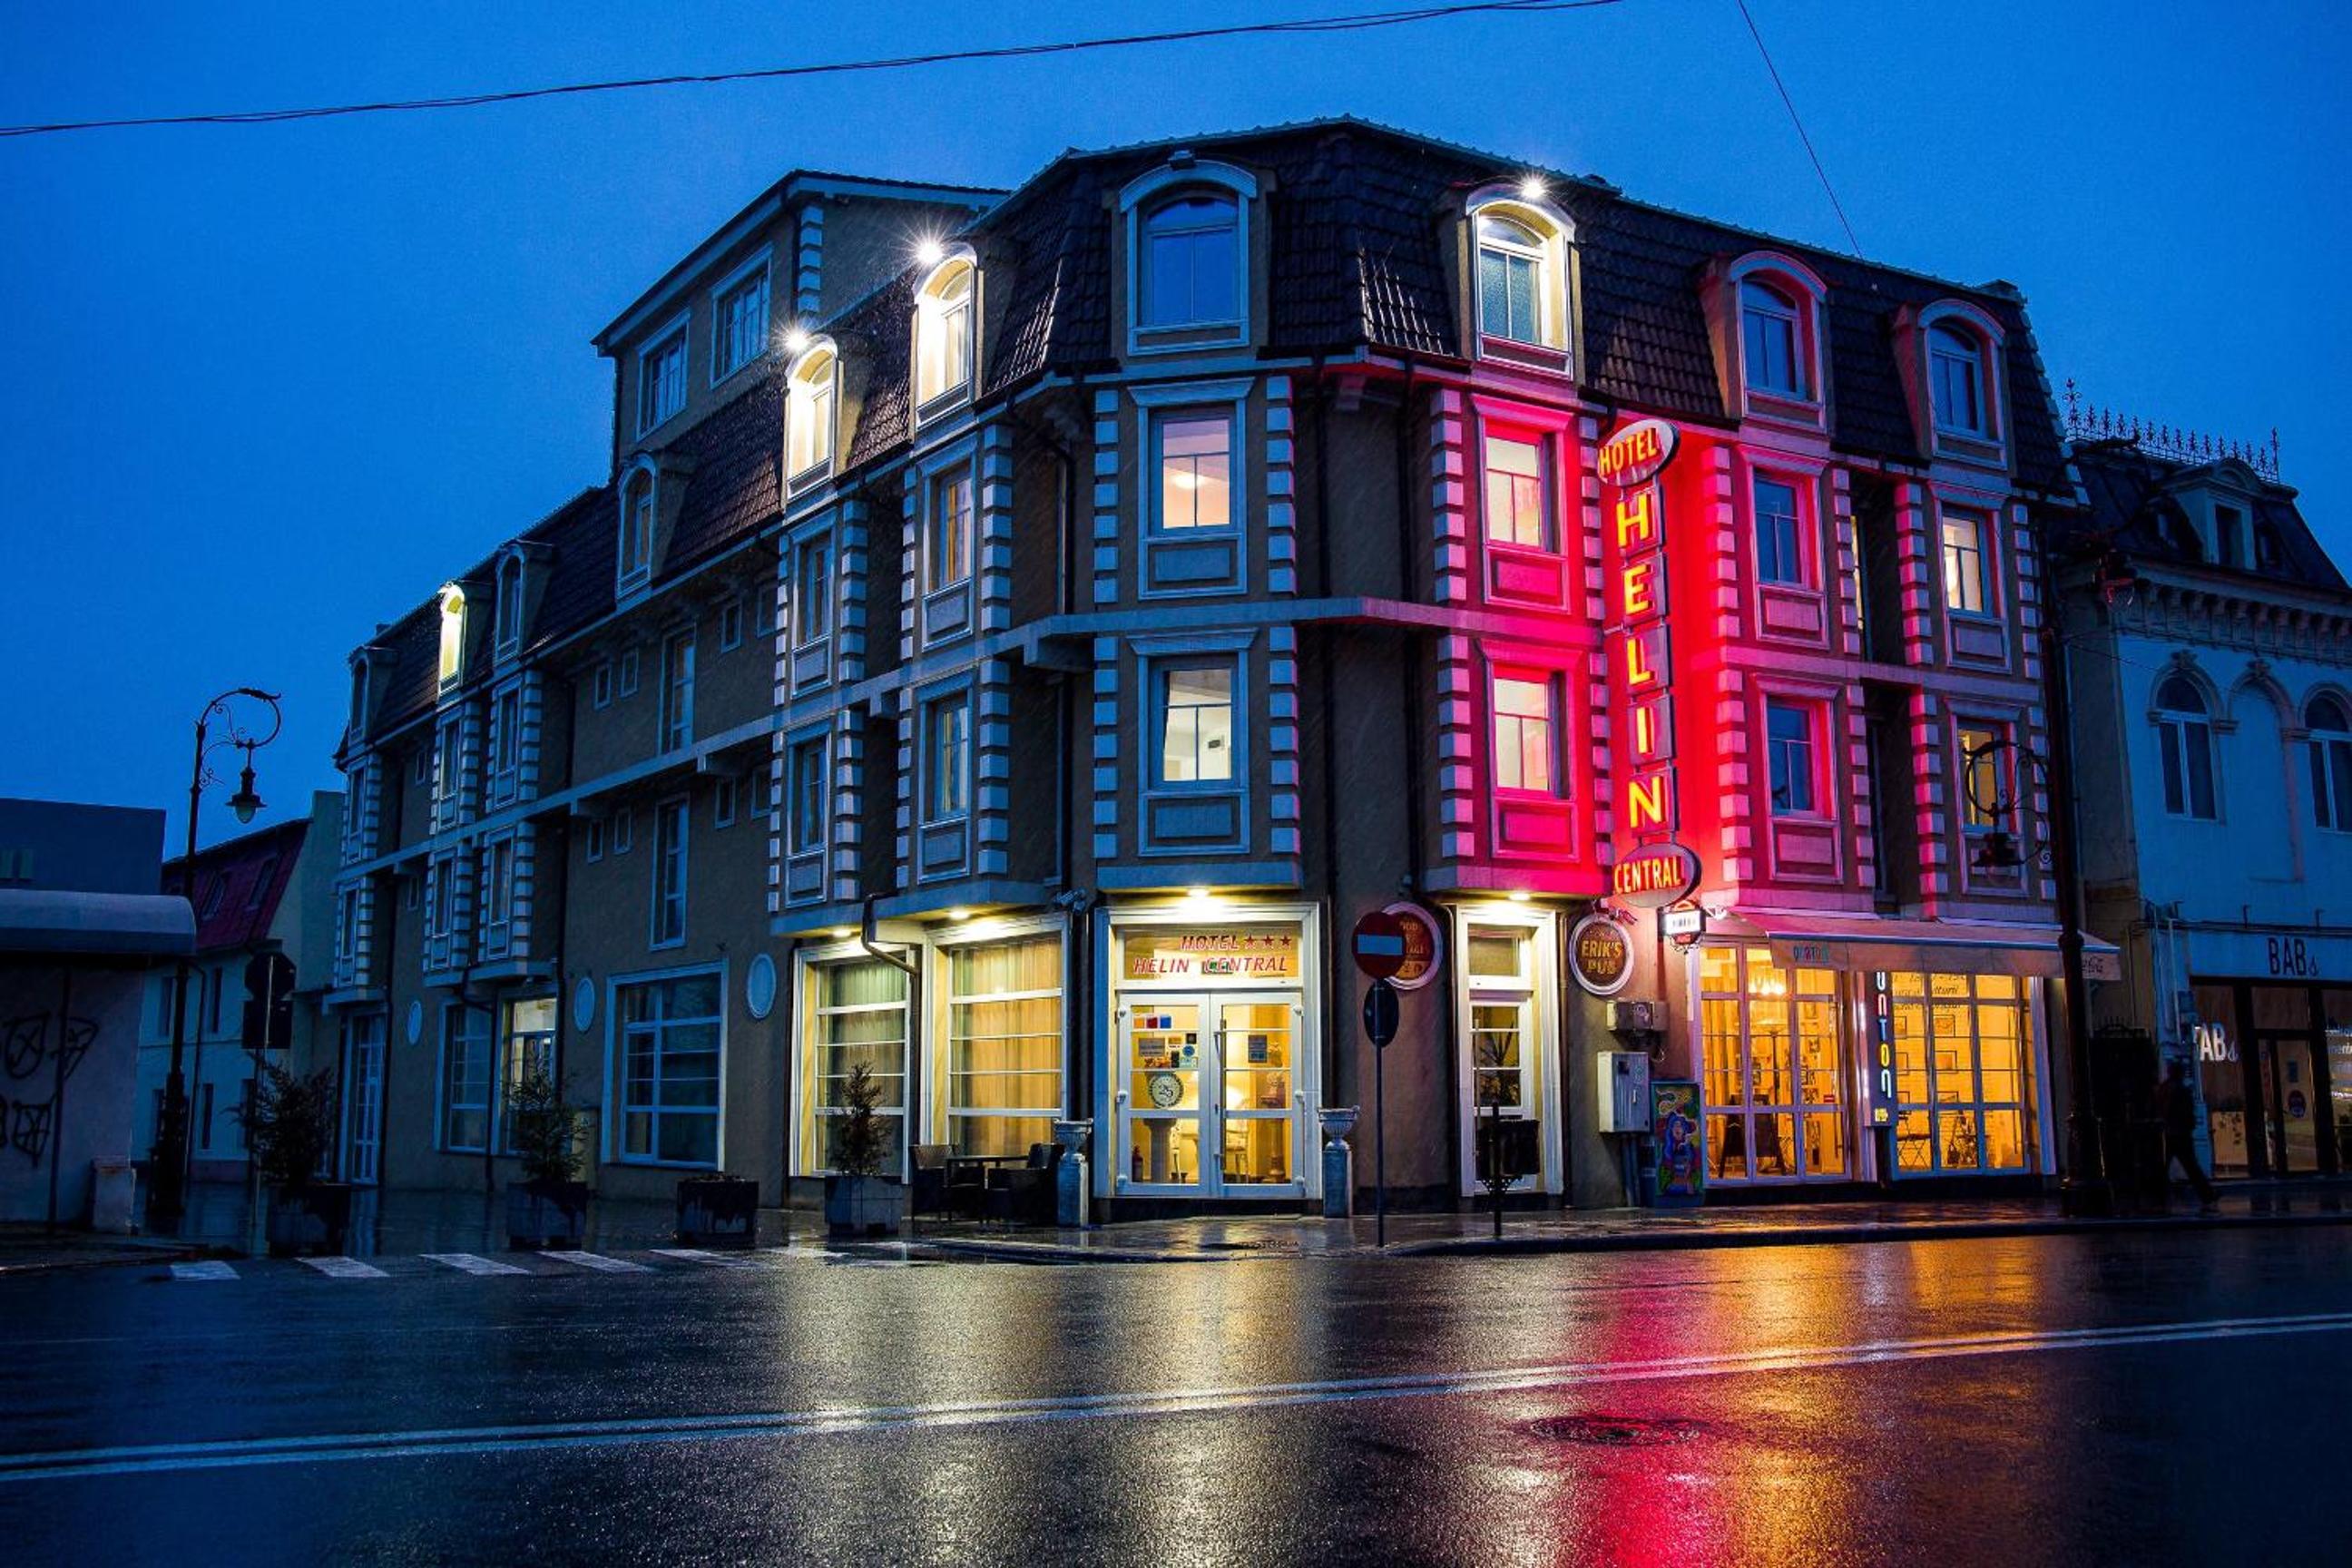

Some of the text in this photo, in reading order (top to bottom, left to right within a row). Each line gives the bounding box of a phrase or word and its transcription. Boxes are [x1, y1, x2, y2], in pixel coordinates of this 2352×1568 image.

[1599, 427, 1658, 476] HOTEL
[1615, 493, 1662, 828] HELIN
[1614, 856, 1681, 895] CENTRAL
[1181, 935, 1240, 950] HOTEL
[1582, 939, 1623, 958] ERIK'S
[1134, 956, 1288, 974] HELIN CENTRAL
[1587, 959, 1617, 975] PUB
